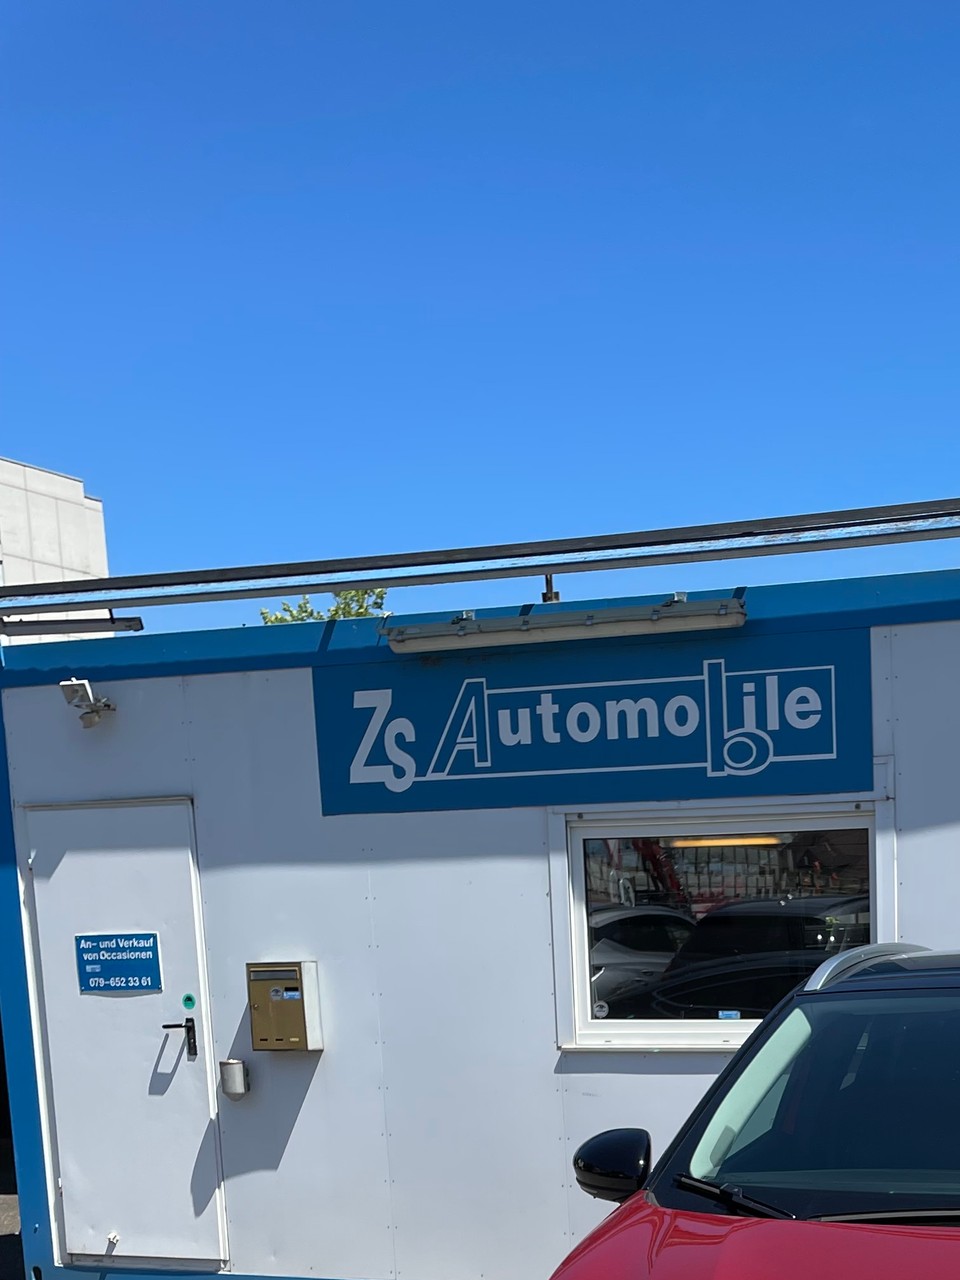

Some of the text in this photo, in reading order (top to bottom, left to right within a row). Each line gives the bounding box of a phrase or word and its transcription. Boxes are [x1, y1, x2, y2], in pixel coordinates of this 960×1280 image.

[427, 659, 823, 777] Automobile
[80, 937, 153, 948] An- und Verkauf
[83, 950, 153, 961] von Occasionen
[89, 976, 152, 987] 079-652 33 61
